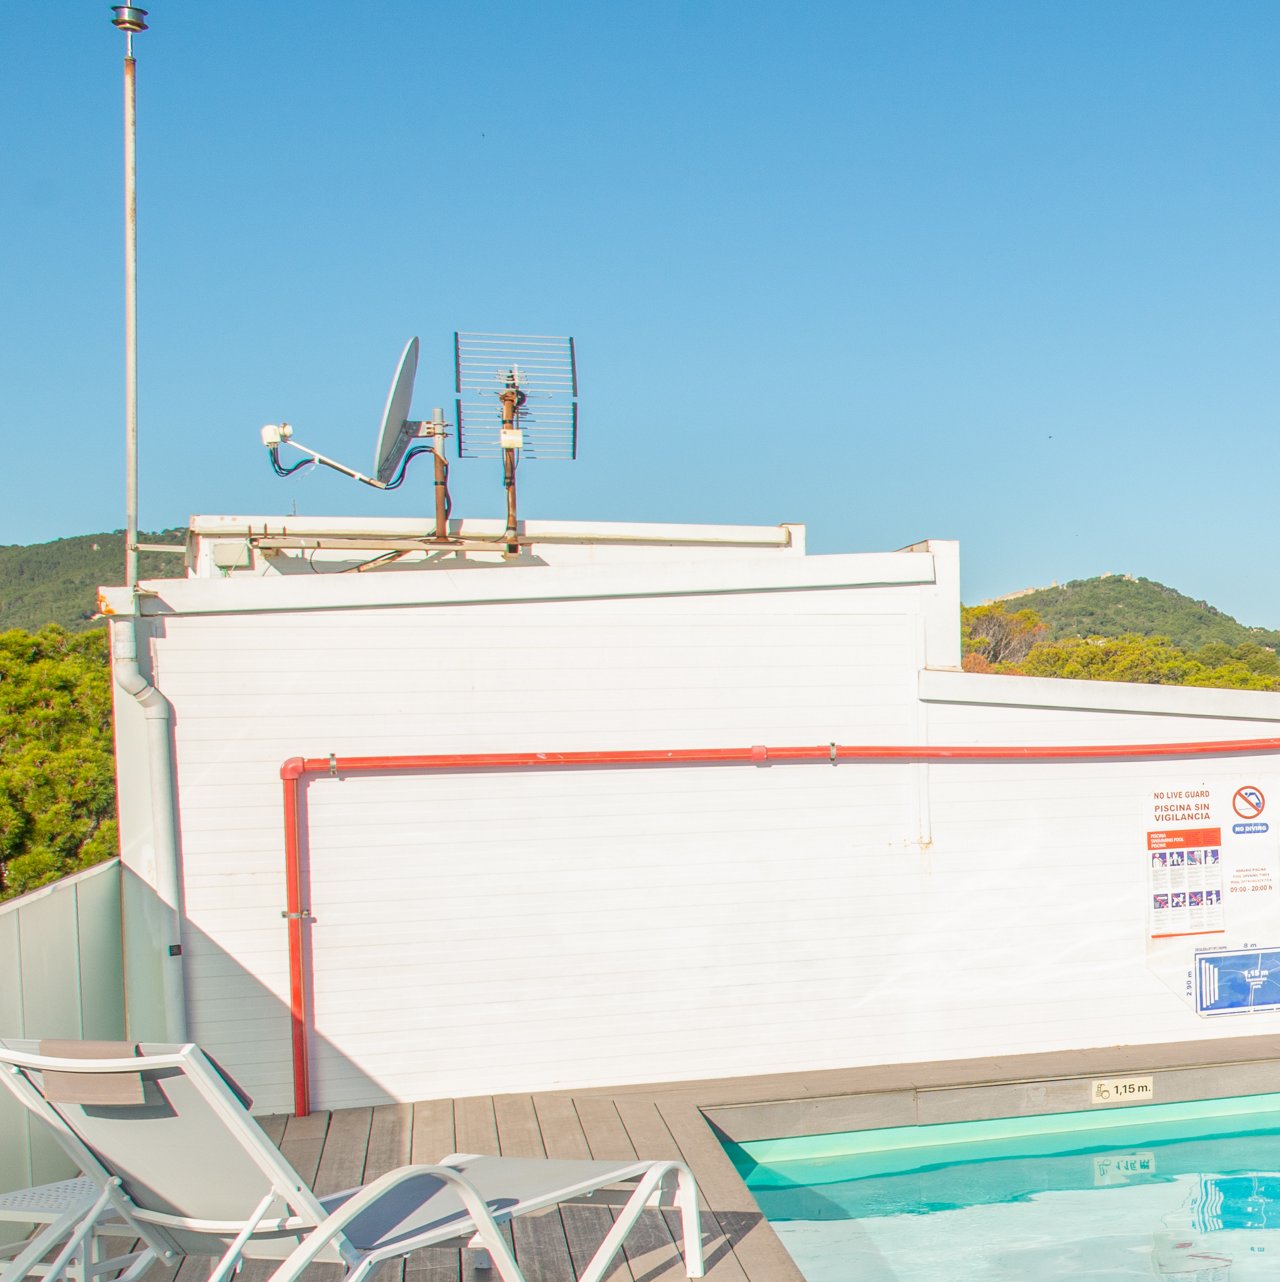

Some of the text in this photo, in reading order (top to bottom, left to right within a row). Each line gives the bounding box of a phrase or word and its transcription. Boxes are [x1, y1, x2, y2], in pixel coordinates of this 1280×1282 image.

[1153, 790, 1210, 800] NO LIVE GUARD
[1154, 803, 1210, 813] PISCINA SIN
[1154, 812, 1211, 822] VIGILANCIA
[1113, 1083, 1151, 1096] 1,15 m.
